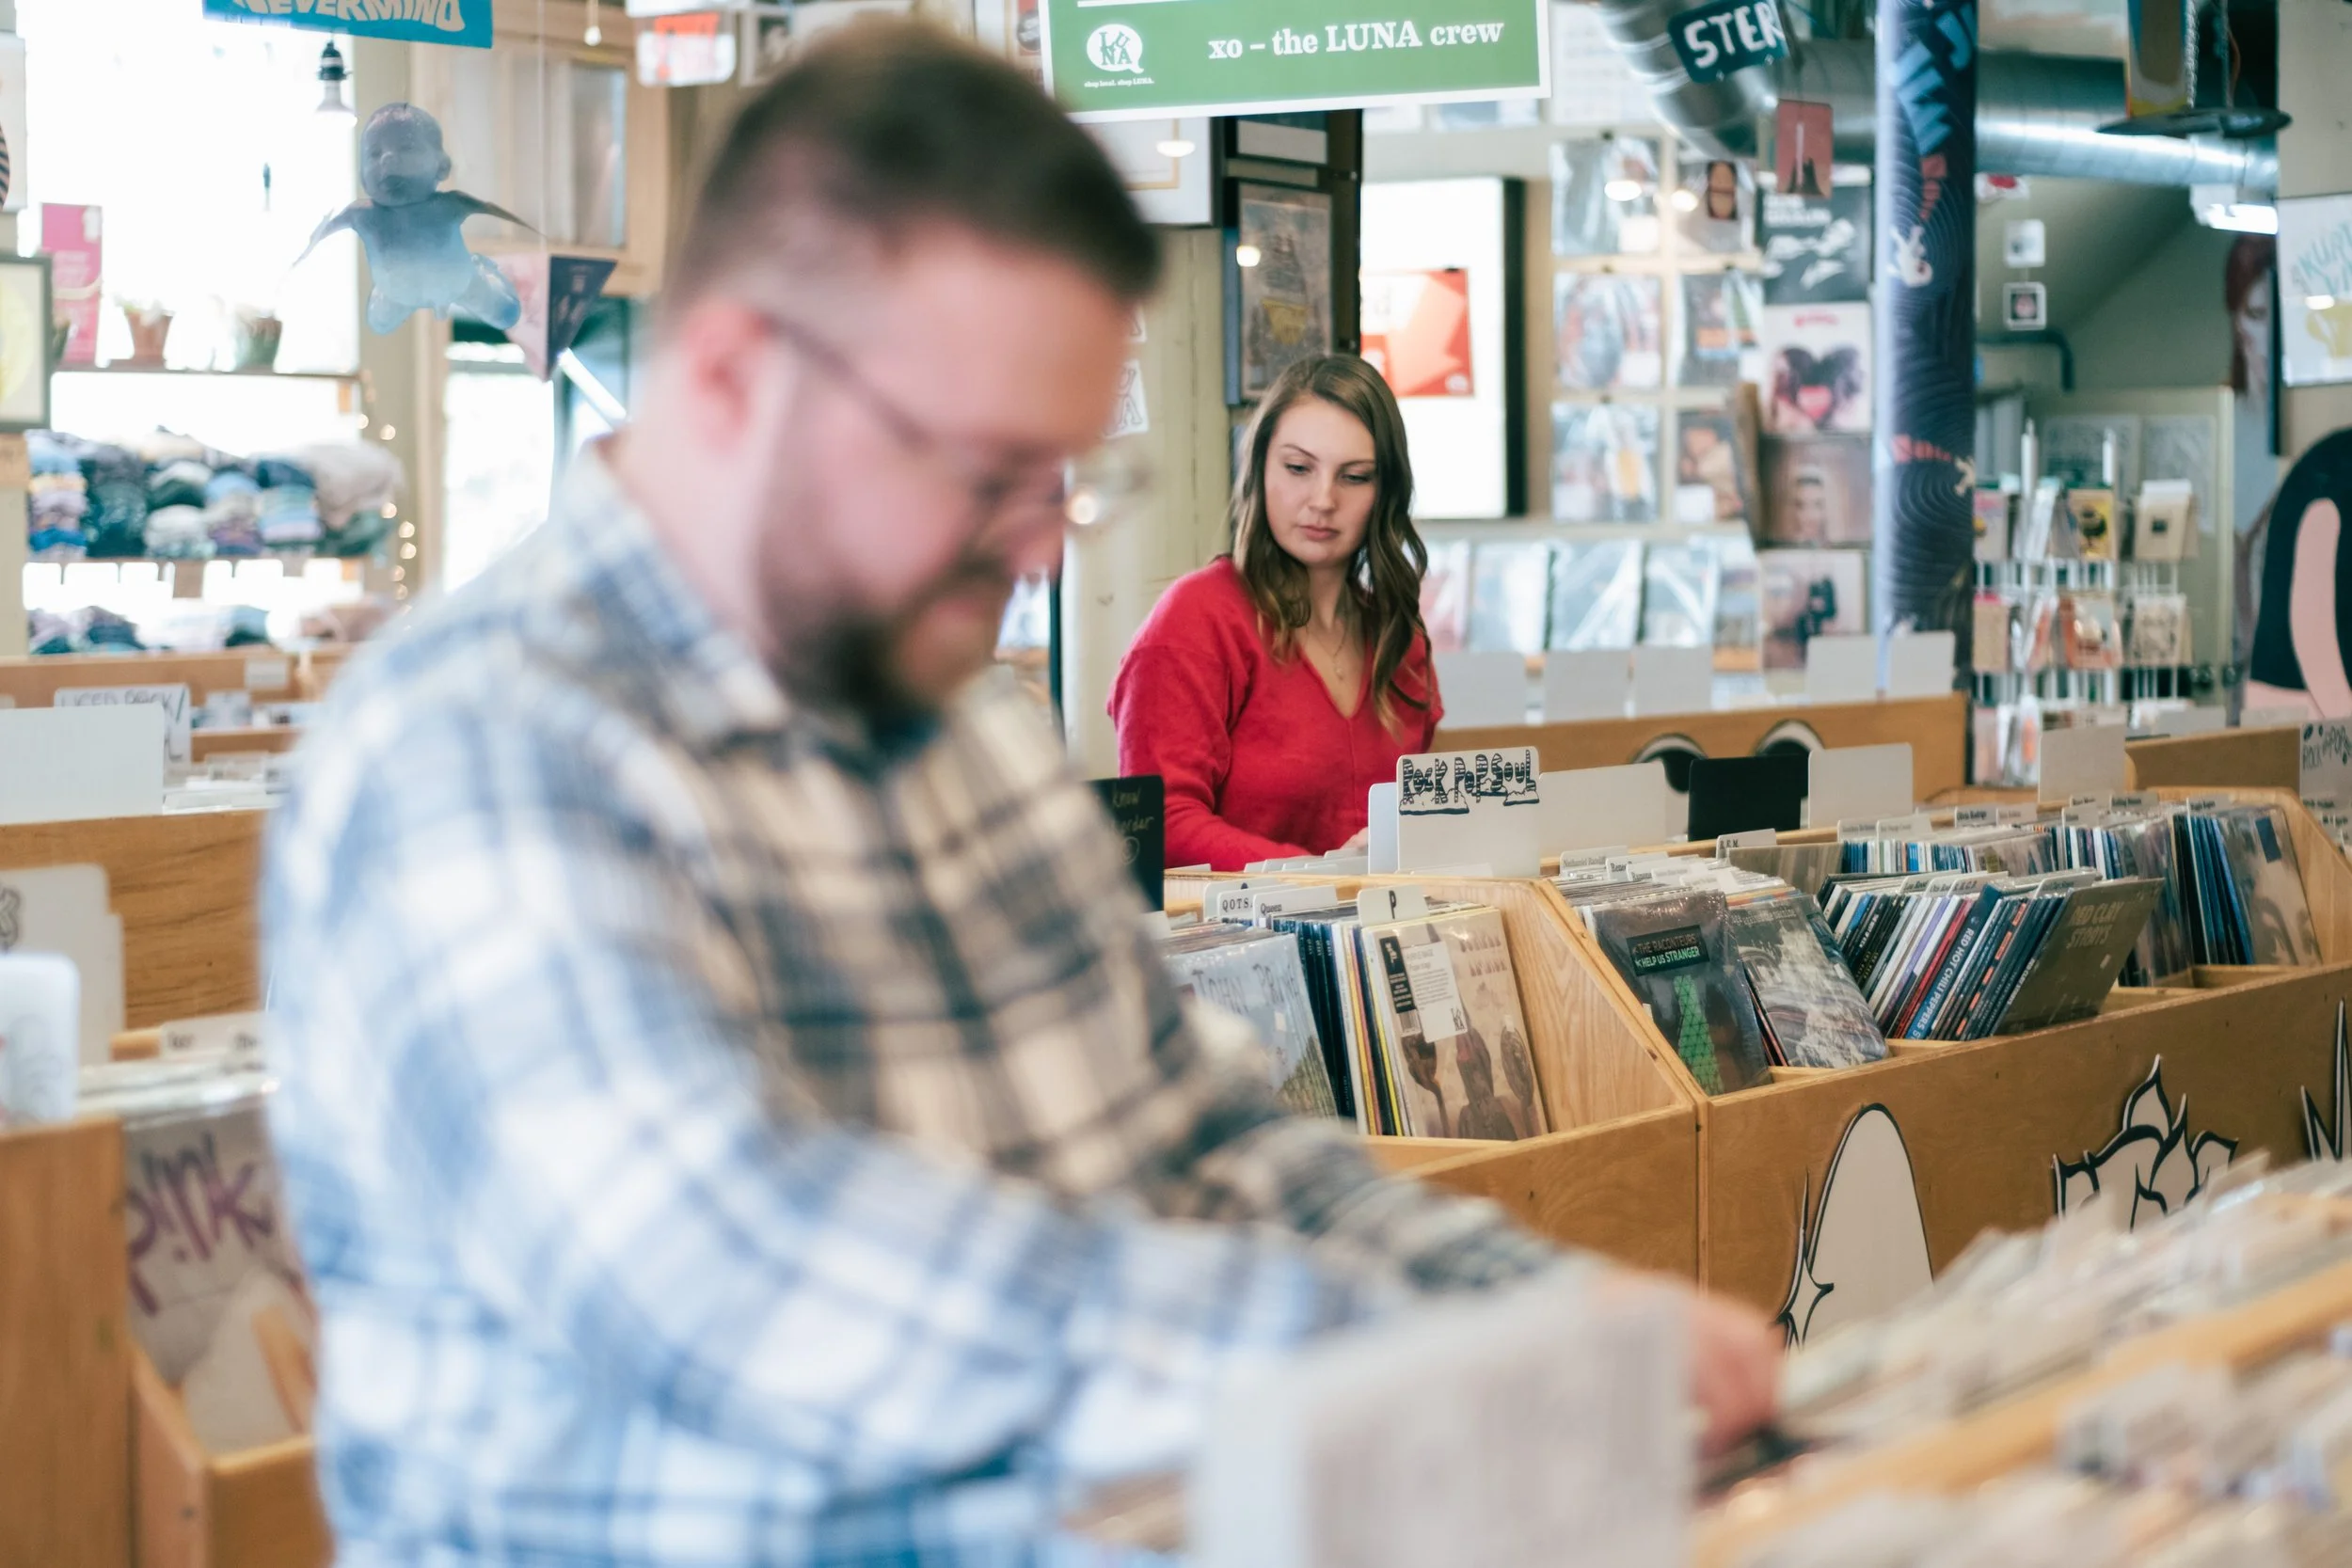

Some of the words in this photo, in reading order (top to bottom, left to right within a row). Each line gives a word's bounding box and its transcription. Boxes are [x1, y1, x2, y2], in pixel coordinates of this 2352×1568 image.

[1208, 39, 1243, 59] xo
[1272, 28, 1318, 55] the
[1325, 21, 1422, 52] LUNA
[1430, 23, 1503, 46] crew
[1222, 897, 1253, 913] QOTS
[1260, 903, 1282, 915] Queen
[1389, 890, 1397, 919] P
[1963, 927, 1975, 946] RED
[1641, 956, 1657, 968] HELP
[1657, 953, 1665, 964] US
[1664, 946, 1701, 962] STRANGER
[1951, 947, 1965, 968] HOT
[1938, 967, 1954, 992] CHILI
[1916, 991, 1942, 1030] PEPPERS
